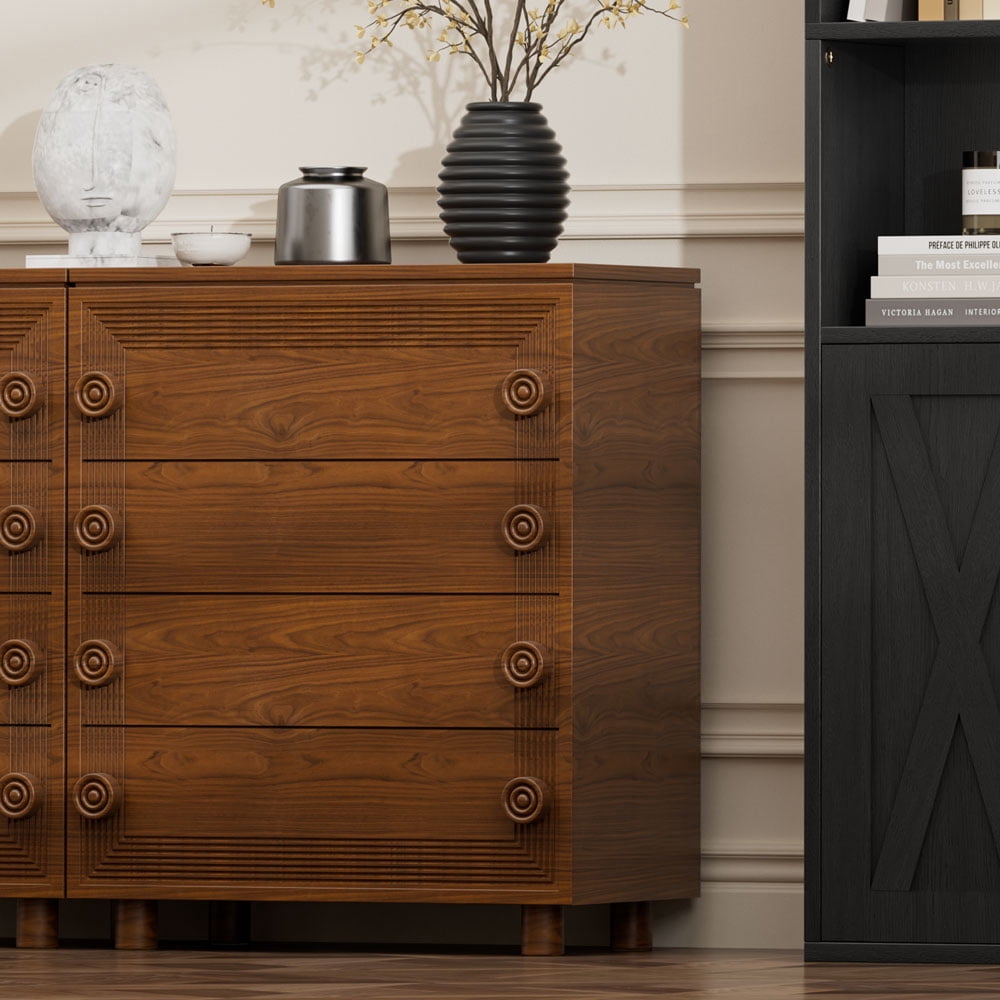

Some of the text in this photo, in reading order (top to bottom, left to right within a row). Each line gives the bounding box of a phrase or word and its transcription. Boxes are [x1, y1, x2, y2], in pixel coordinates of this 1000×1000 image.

[955, 240, 964, 249] DE
[964, 240, 991, 249] PHILIPPE
[914, 259, 934, 271] The
[935, 259, 961, 270] Most
[901, 280, 957, 293] KONSTEN
[881, 308, 922, 317] VICTORIA
[924, 308, 954, 317] HAGAN
